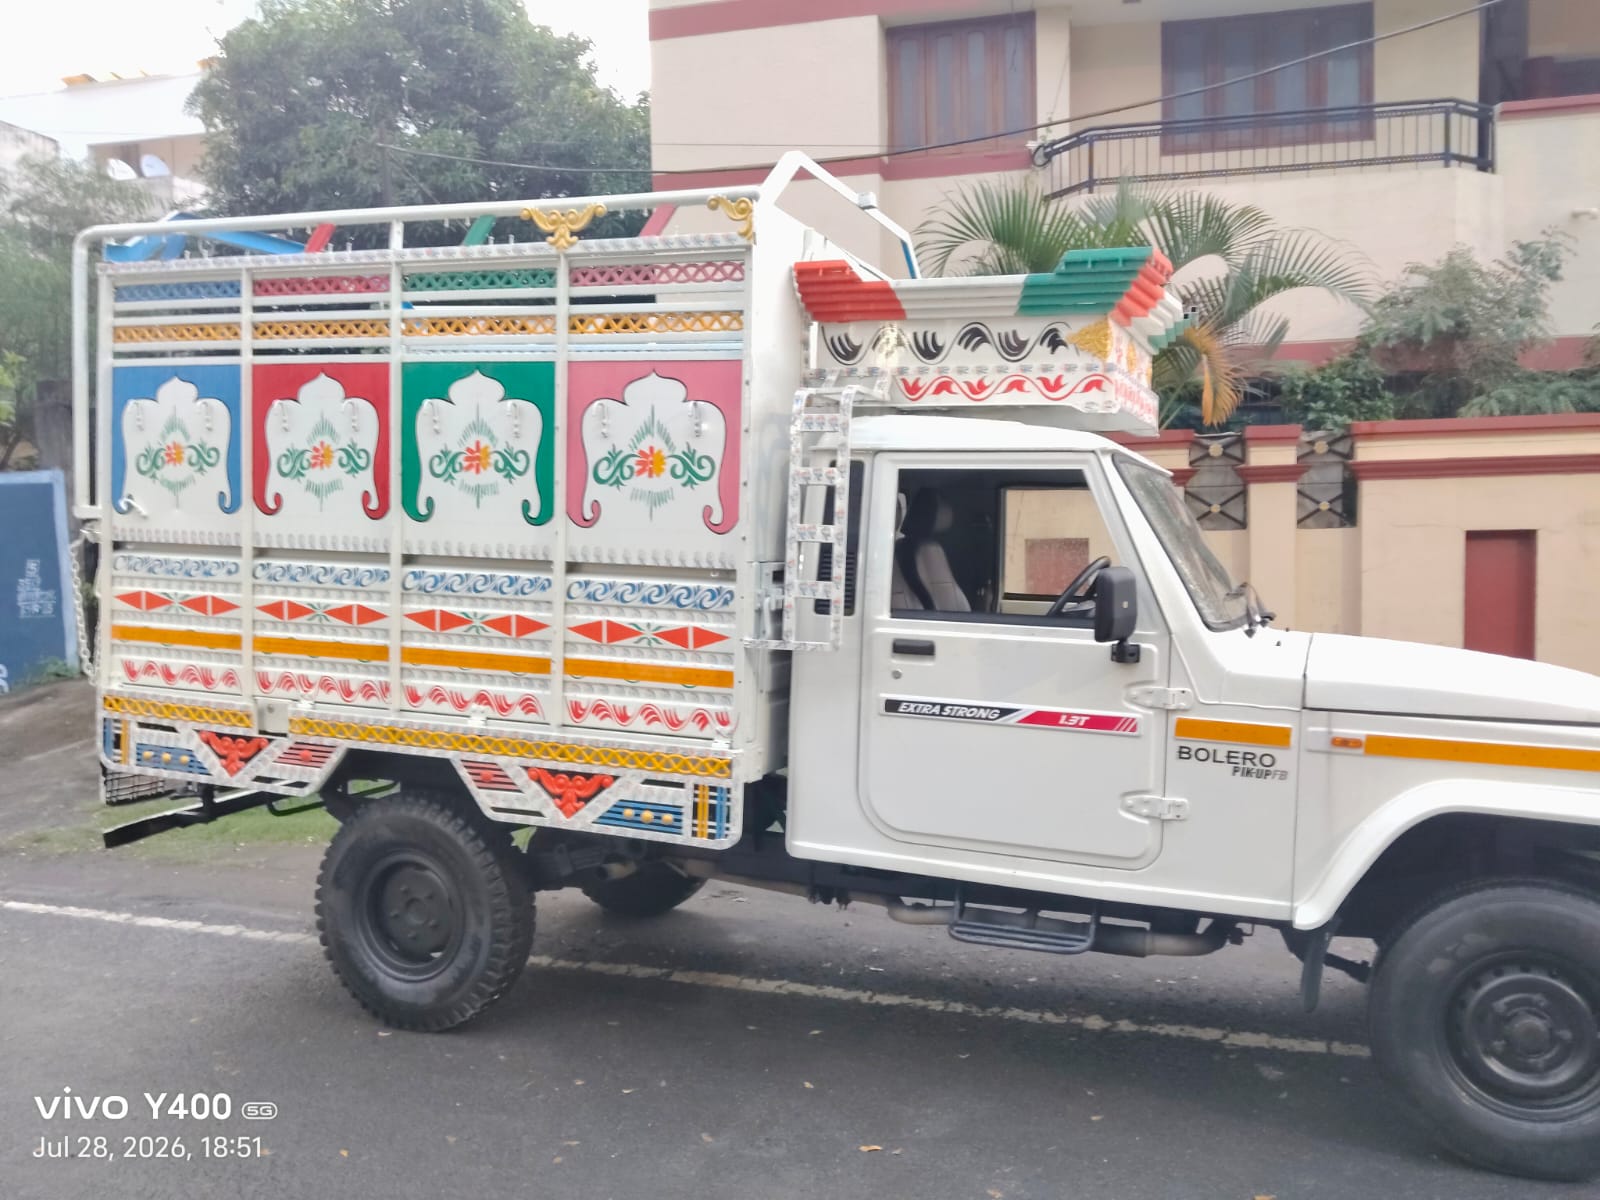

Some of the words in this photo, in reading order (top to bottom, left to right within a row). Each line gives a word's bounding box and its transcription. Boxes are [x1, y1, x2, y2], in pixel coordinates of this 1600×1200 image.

[897, 702, 941, 715] EXTRA
[941, 705, 1001, 719] STRONG
[1177, 745, 1277, 768] BOLERO
